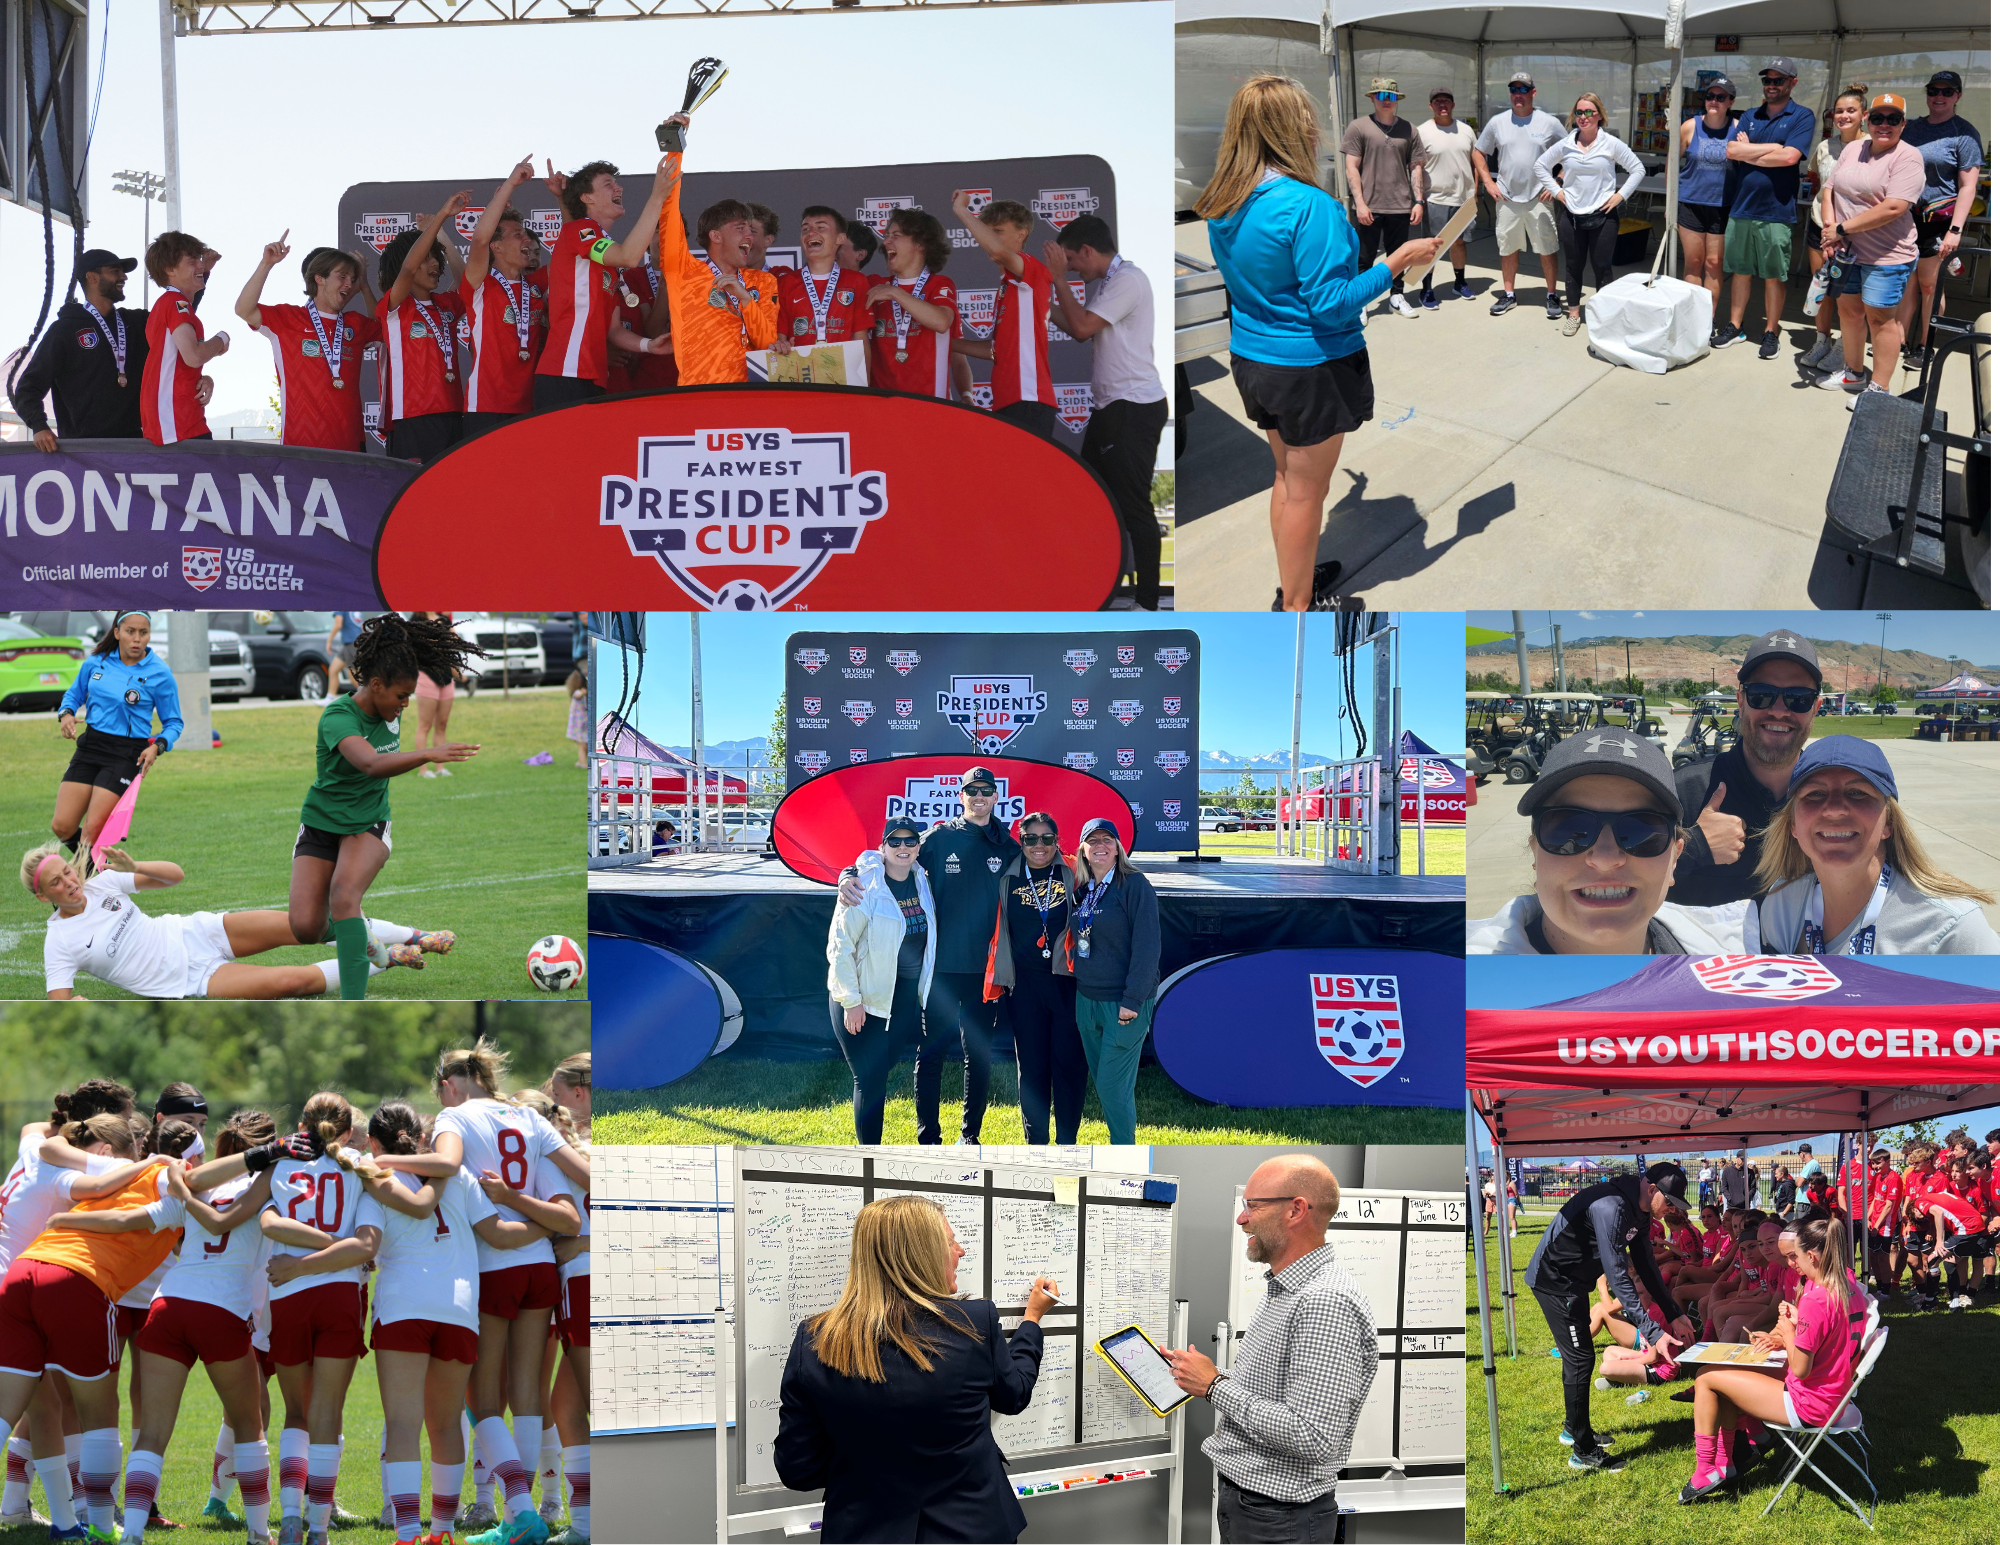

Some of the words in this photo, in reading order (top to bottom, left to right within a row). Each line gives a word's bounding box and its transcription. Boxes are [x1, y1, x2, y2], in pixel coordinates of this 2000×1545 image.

[1032, 197, 1100, 212] PRESIDENTS
[375, 217, 398, 225] USYS
[1054, 210, 1078, 219] CUP
[355, 222, 418, 234] PRESIDENTS
[524, 220, 562, 231] PRESID
[545, 230, 561, 239] CU
[801, 270, 822, 316] CHAMPION
[820, 270, 839, 316] CHAMPION
[971, 311, 994, 320] CUP
[1064, 406, 1087, 414] CUP
[706, 433, 780, 451] USYS
[687, 460, 802, 477] FARWEST
[605, 475, 883, 520] PRESIDENTS
[695, 524, 791, 554] CUP
[226, 547, 255, 561] US
[22, 564, 75, 582] Official
[80, 562, 148, 581] Member
[151, 562, 169, 579] of
[225, 560, 294, 577] YOUTH
[225, 576, 304, 591] SOCCER
[973, 683, 1010, 693] USYS
[938, 693, 1046, 711] PRESIDENTS
[976, 712, 1010, 725] CUP
[939, 777, 963, 786] USY
[929, 790, 960, 798] FARW
[888, 798, 1023, 818] PRESIDTS
[1313, 976, 1396, 999] USYS
[498, 1128, 528, 1190] 8
[759, 1153, 822, 1170] USYS
[829, 1160, 855, 1174] info
[887, 1162, 919, 1181] RAC
[930, 1169, 952, 1183] info
[958, 1171, 978, 1181] Golf
[1013, 1173, 1053, 1189] FOOD
[288, 1172, 344, 1233] 20
[1416, 1210, 1437, 1222] June
[1411, 1343, 1427, 1351] June
